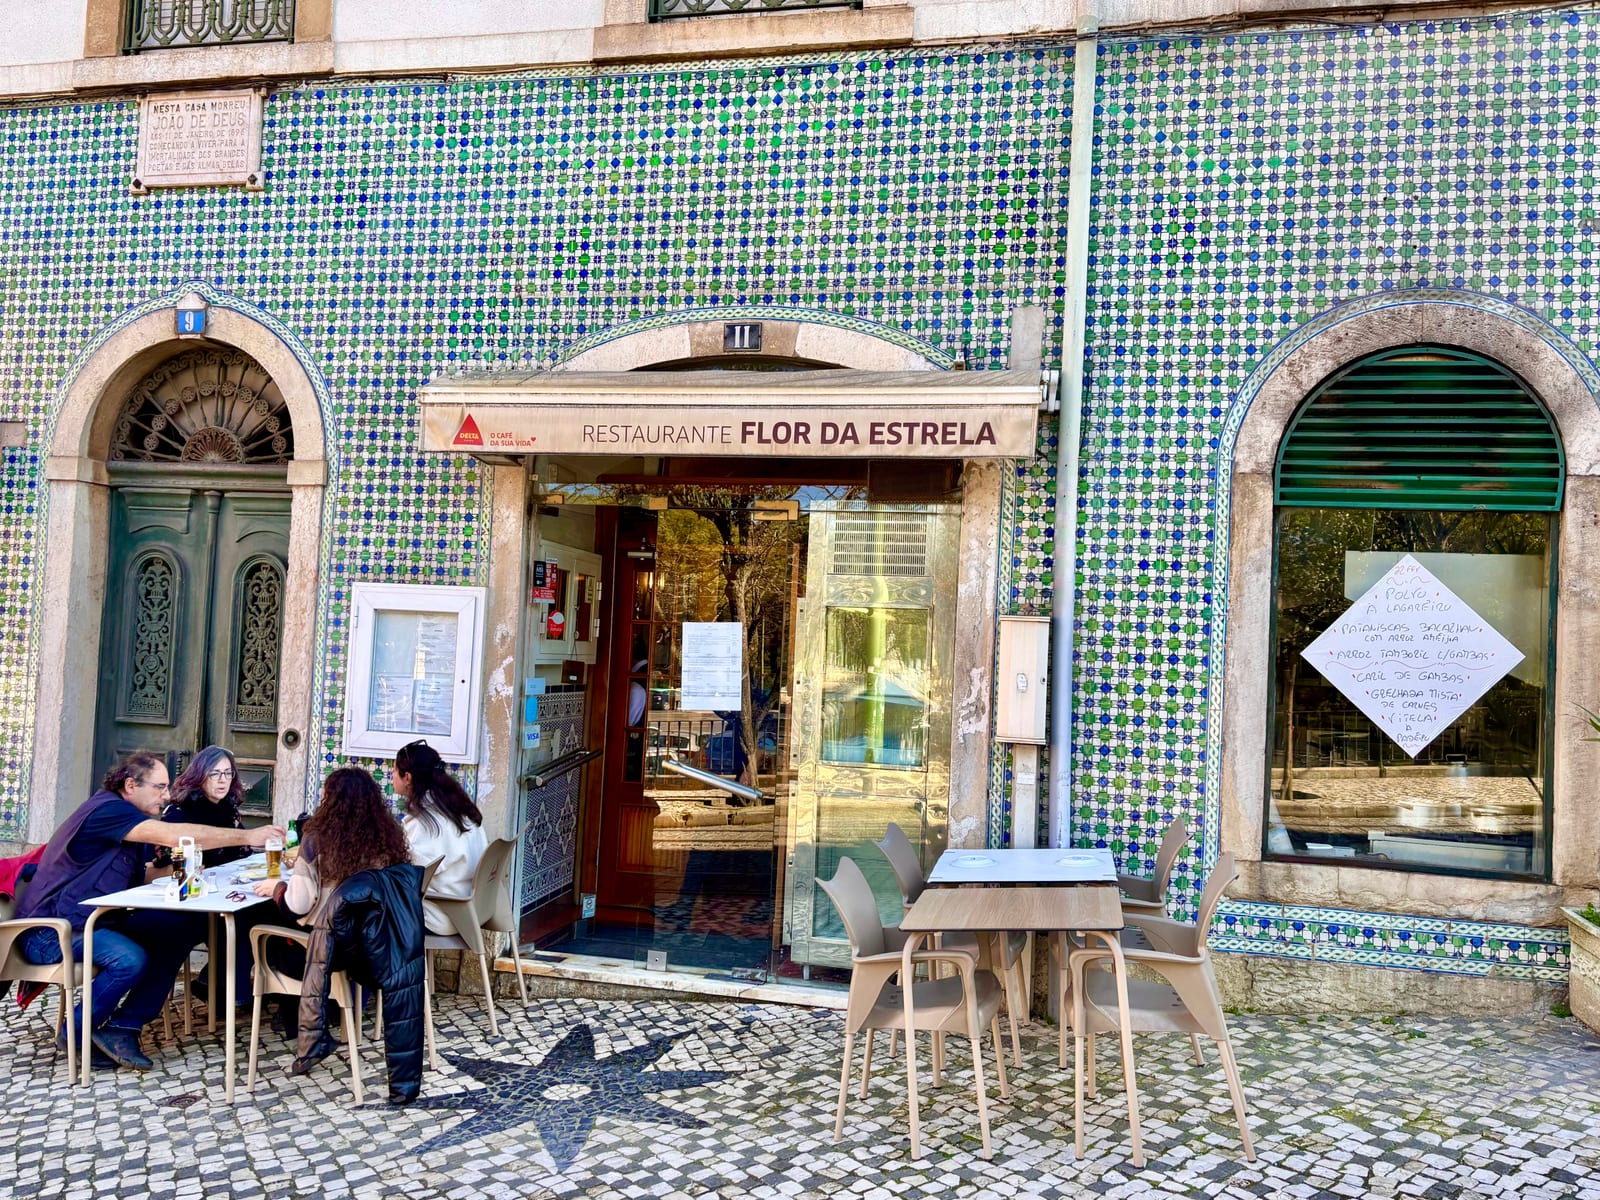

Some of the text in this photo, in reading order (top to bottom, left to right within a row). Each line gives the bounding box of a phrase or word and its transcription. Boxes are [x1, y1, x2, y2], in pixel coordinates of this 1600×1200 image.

[154, 100, 246, 114] NESTA CASA MORREU
[152, 112, 246, 130] JOÃO DE DEUS
[174, 131, 183, 139] DE
[186, 130, 214, 139] JANEIRO
[150, 138, 246, 151] COMEÇANDO A VIVER PARA A
[199, 150, 212, 159] DOS
[214, 149, 246, 158] GRANDES
[176, 162, 180, 171] E
[198, 161, 220, 170] ALMAS
[184, 312, 194, 332] 9
[583, 422, 996, 444] RESTAURANTE FLOR DA ESTRELA
[1386, 588, 1427, 600] POLVO
[1342, 622, 1479, 634] PATANISCAS BACALHAU
[1364, 634, 1382, 642] COM
[1337, 649, 1488, 660] ARROZ TAMBORIL C/GAMBAS
[1356, 671, 1464, 684] CARIL DE GAMBAS
[1370, 688, 1459, 701] GRELHADA MISTA
[1402, 700, 1438, 712] CARNES
[1388, 712, 1434, 724] VITELA
[527, 732, 540, 740] VISA
